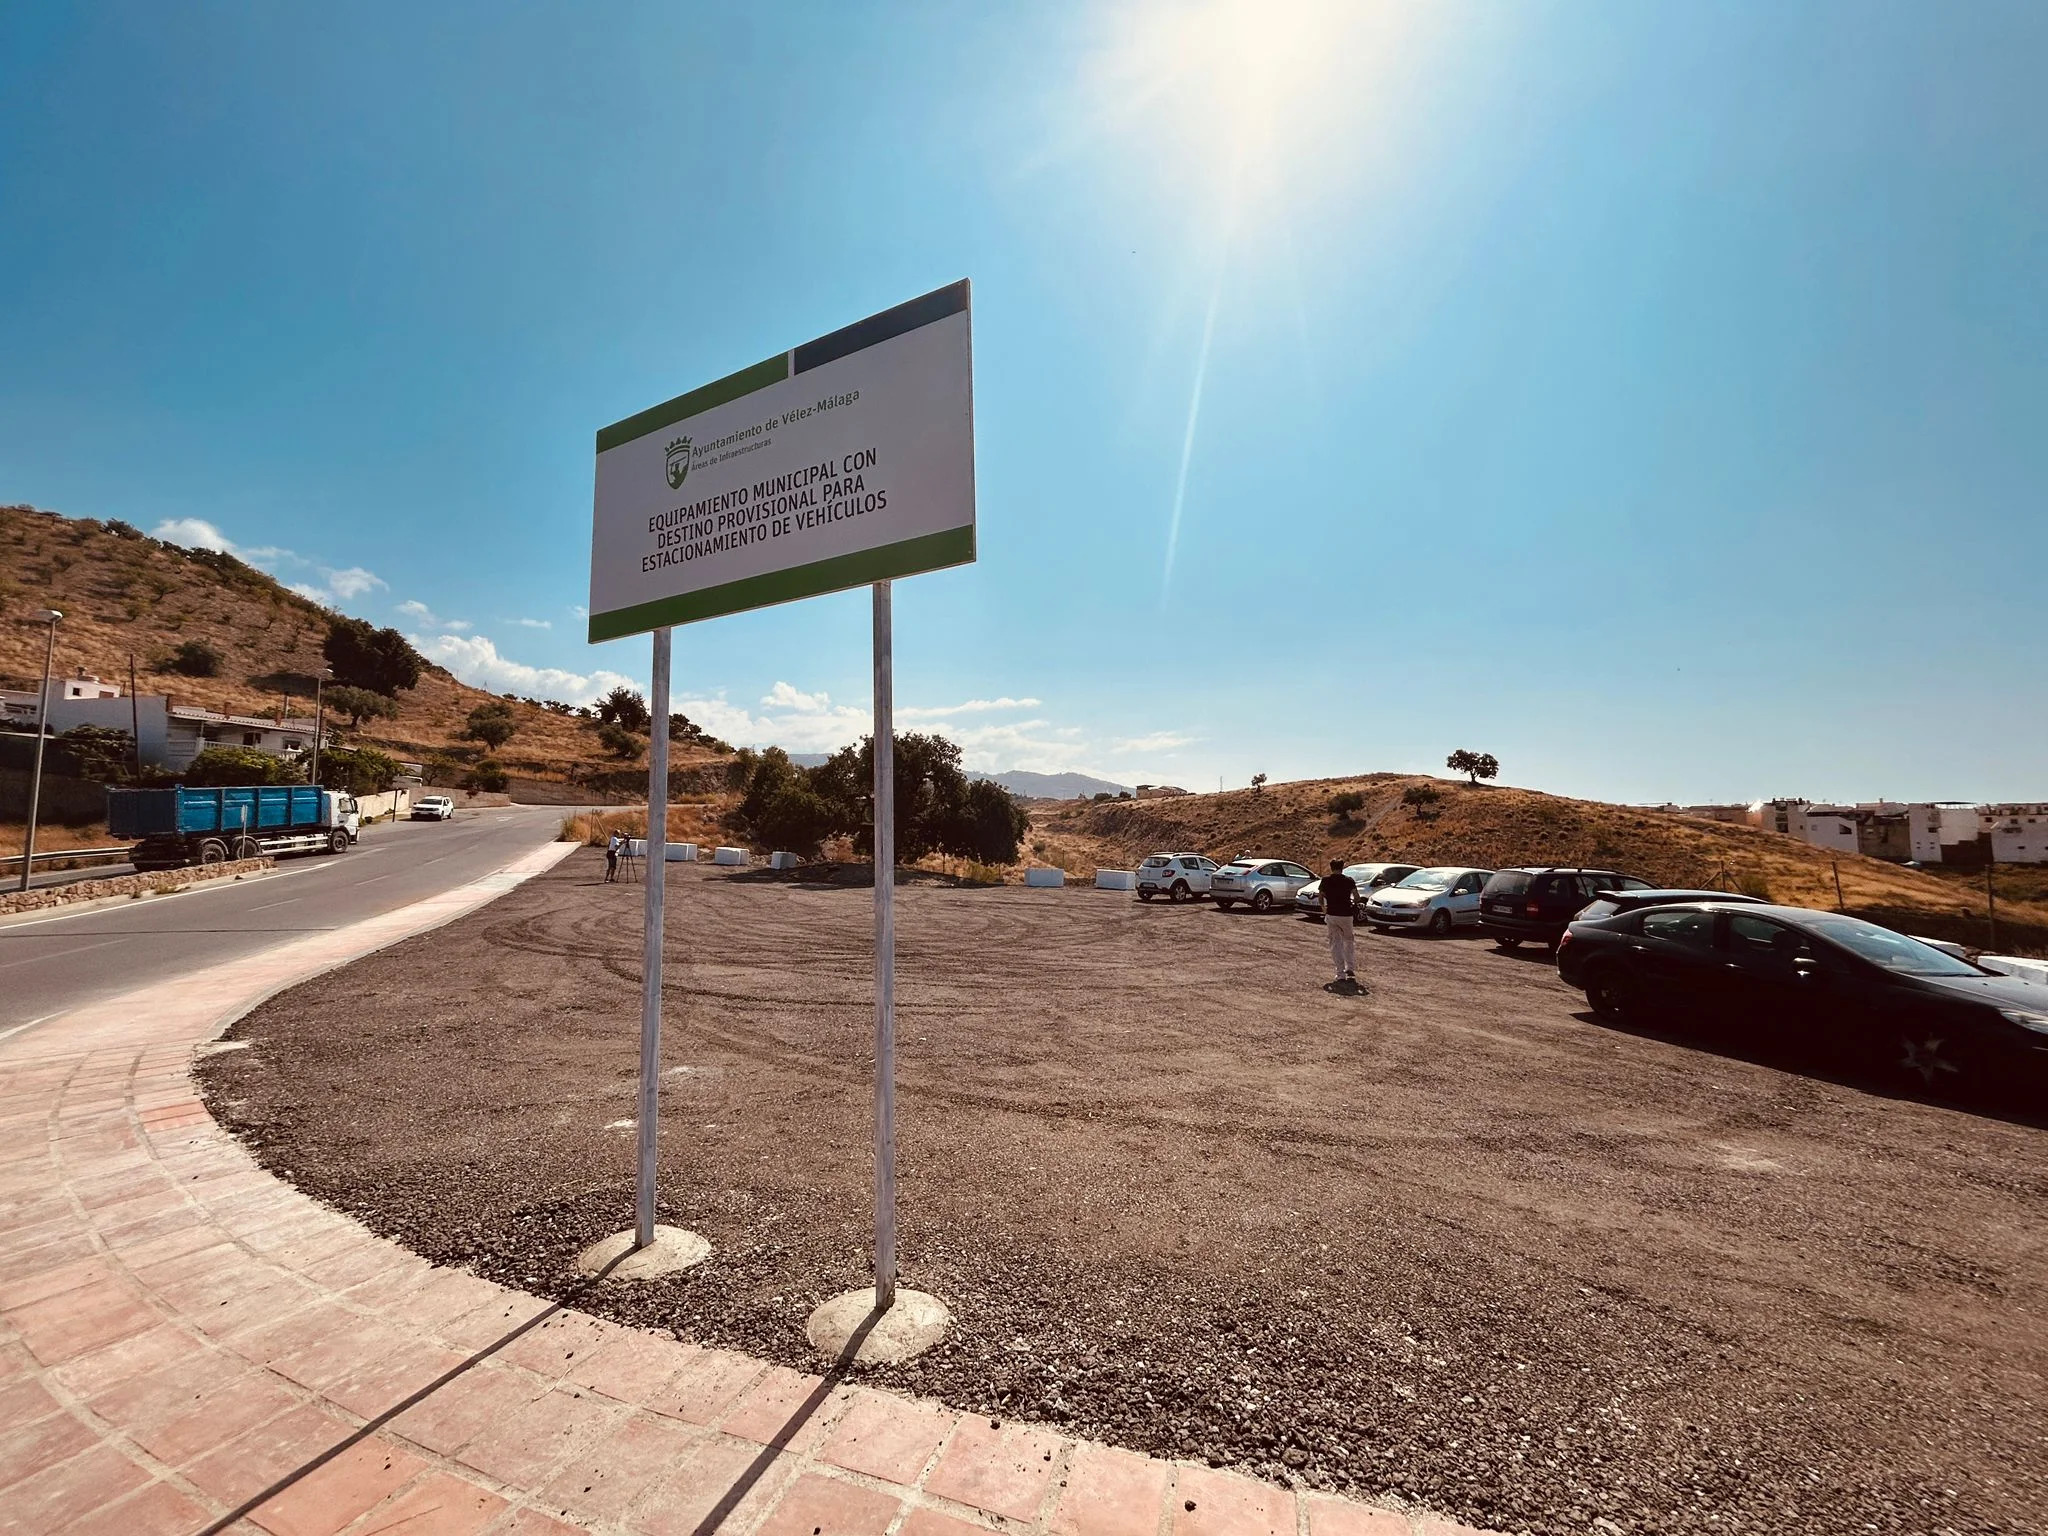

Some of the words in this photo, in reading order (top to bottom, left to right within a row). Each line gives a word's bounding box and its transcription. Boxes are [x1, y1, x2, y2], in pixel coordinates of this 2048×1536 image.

[692, 425, 762, 457] Ayuntamiento
[765, 418, 778, 431] de
[782, 390, 860, 425] Vélez-Málaga
[709, 456, 718, 465] de
[719, 438, 772, 462] Infraestructuras
[649, 488, 748, 533] EQUIPAMIENTO
[753, 461, 838, 501] MUNICIPAL
[843, 448, 876, 473] CON
[658, 519, 713, 549] DESTINO
[718, 489, 817, 532] PROVISIONAL
[823, 474, 865, 502] PARA
[642, 524, 767, 573] ESTACIONAMIENTO
[772, 517, 791, 537] DE
[796, 490, 887, 530] VEHÍCULOS
